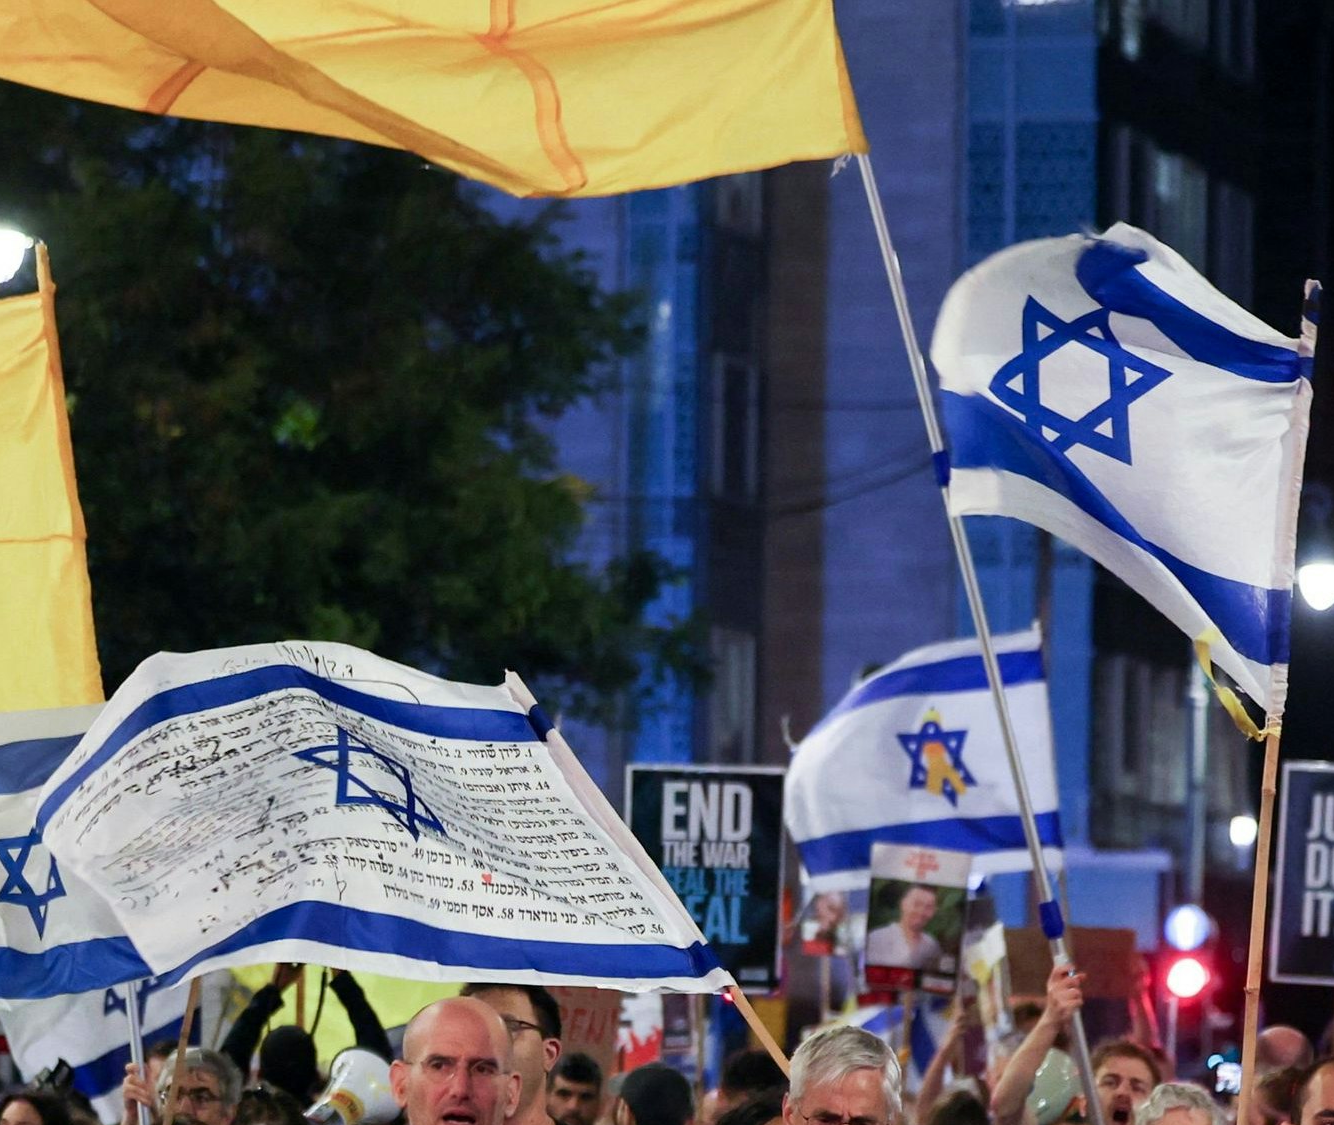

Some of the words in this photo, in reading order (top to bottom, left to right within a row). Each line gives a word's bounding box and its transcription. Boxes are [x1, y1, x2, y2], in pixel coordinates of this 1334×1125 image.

[454, 749, 462, 759] 2.
[467, 746, 497, 759] שתיוי
[498, 746, 521, 760] עידן
[533, 764, 542, 774] 8.
[463, 781, 505, 793] (אברהם)
[507, 780, 531, 792] איתן
[535, 781, 550, 791] 14.
[661, 782, 753, 842] END
[426, 848, 452, 865] ברמן
[662, 841, 698, 867] THE
[703, 842, 750, 869] WAR
[426, 873, 454, 890] נמרוד
[457, 880, 474, 892] 53.
[586, 876, 612, 887] תמיר
[714, 869, 749, 897] THE
[482, 880, 528, 897] אלכסנדר
[590, 891, 625, 902] מוחמד
[442, 900, 468, 915] חממי
[472, 905, 494, 920] אסף
[497, 908, 514, 920] 58.
[518, 908, 558, 923] גודארד
[560, 912, 578, 924] מני
[582, 914, 596, 925] 57.
[683, 896, 749, 944] EAL
[628, 923, 646, 936] עוז
[650, 923, 664, 934] 56.
